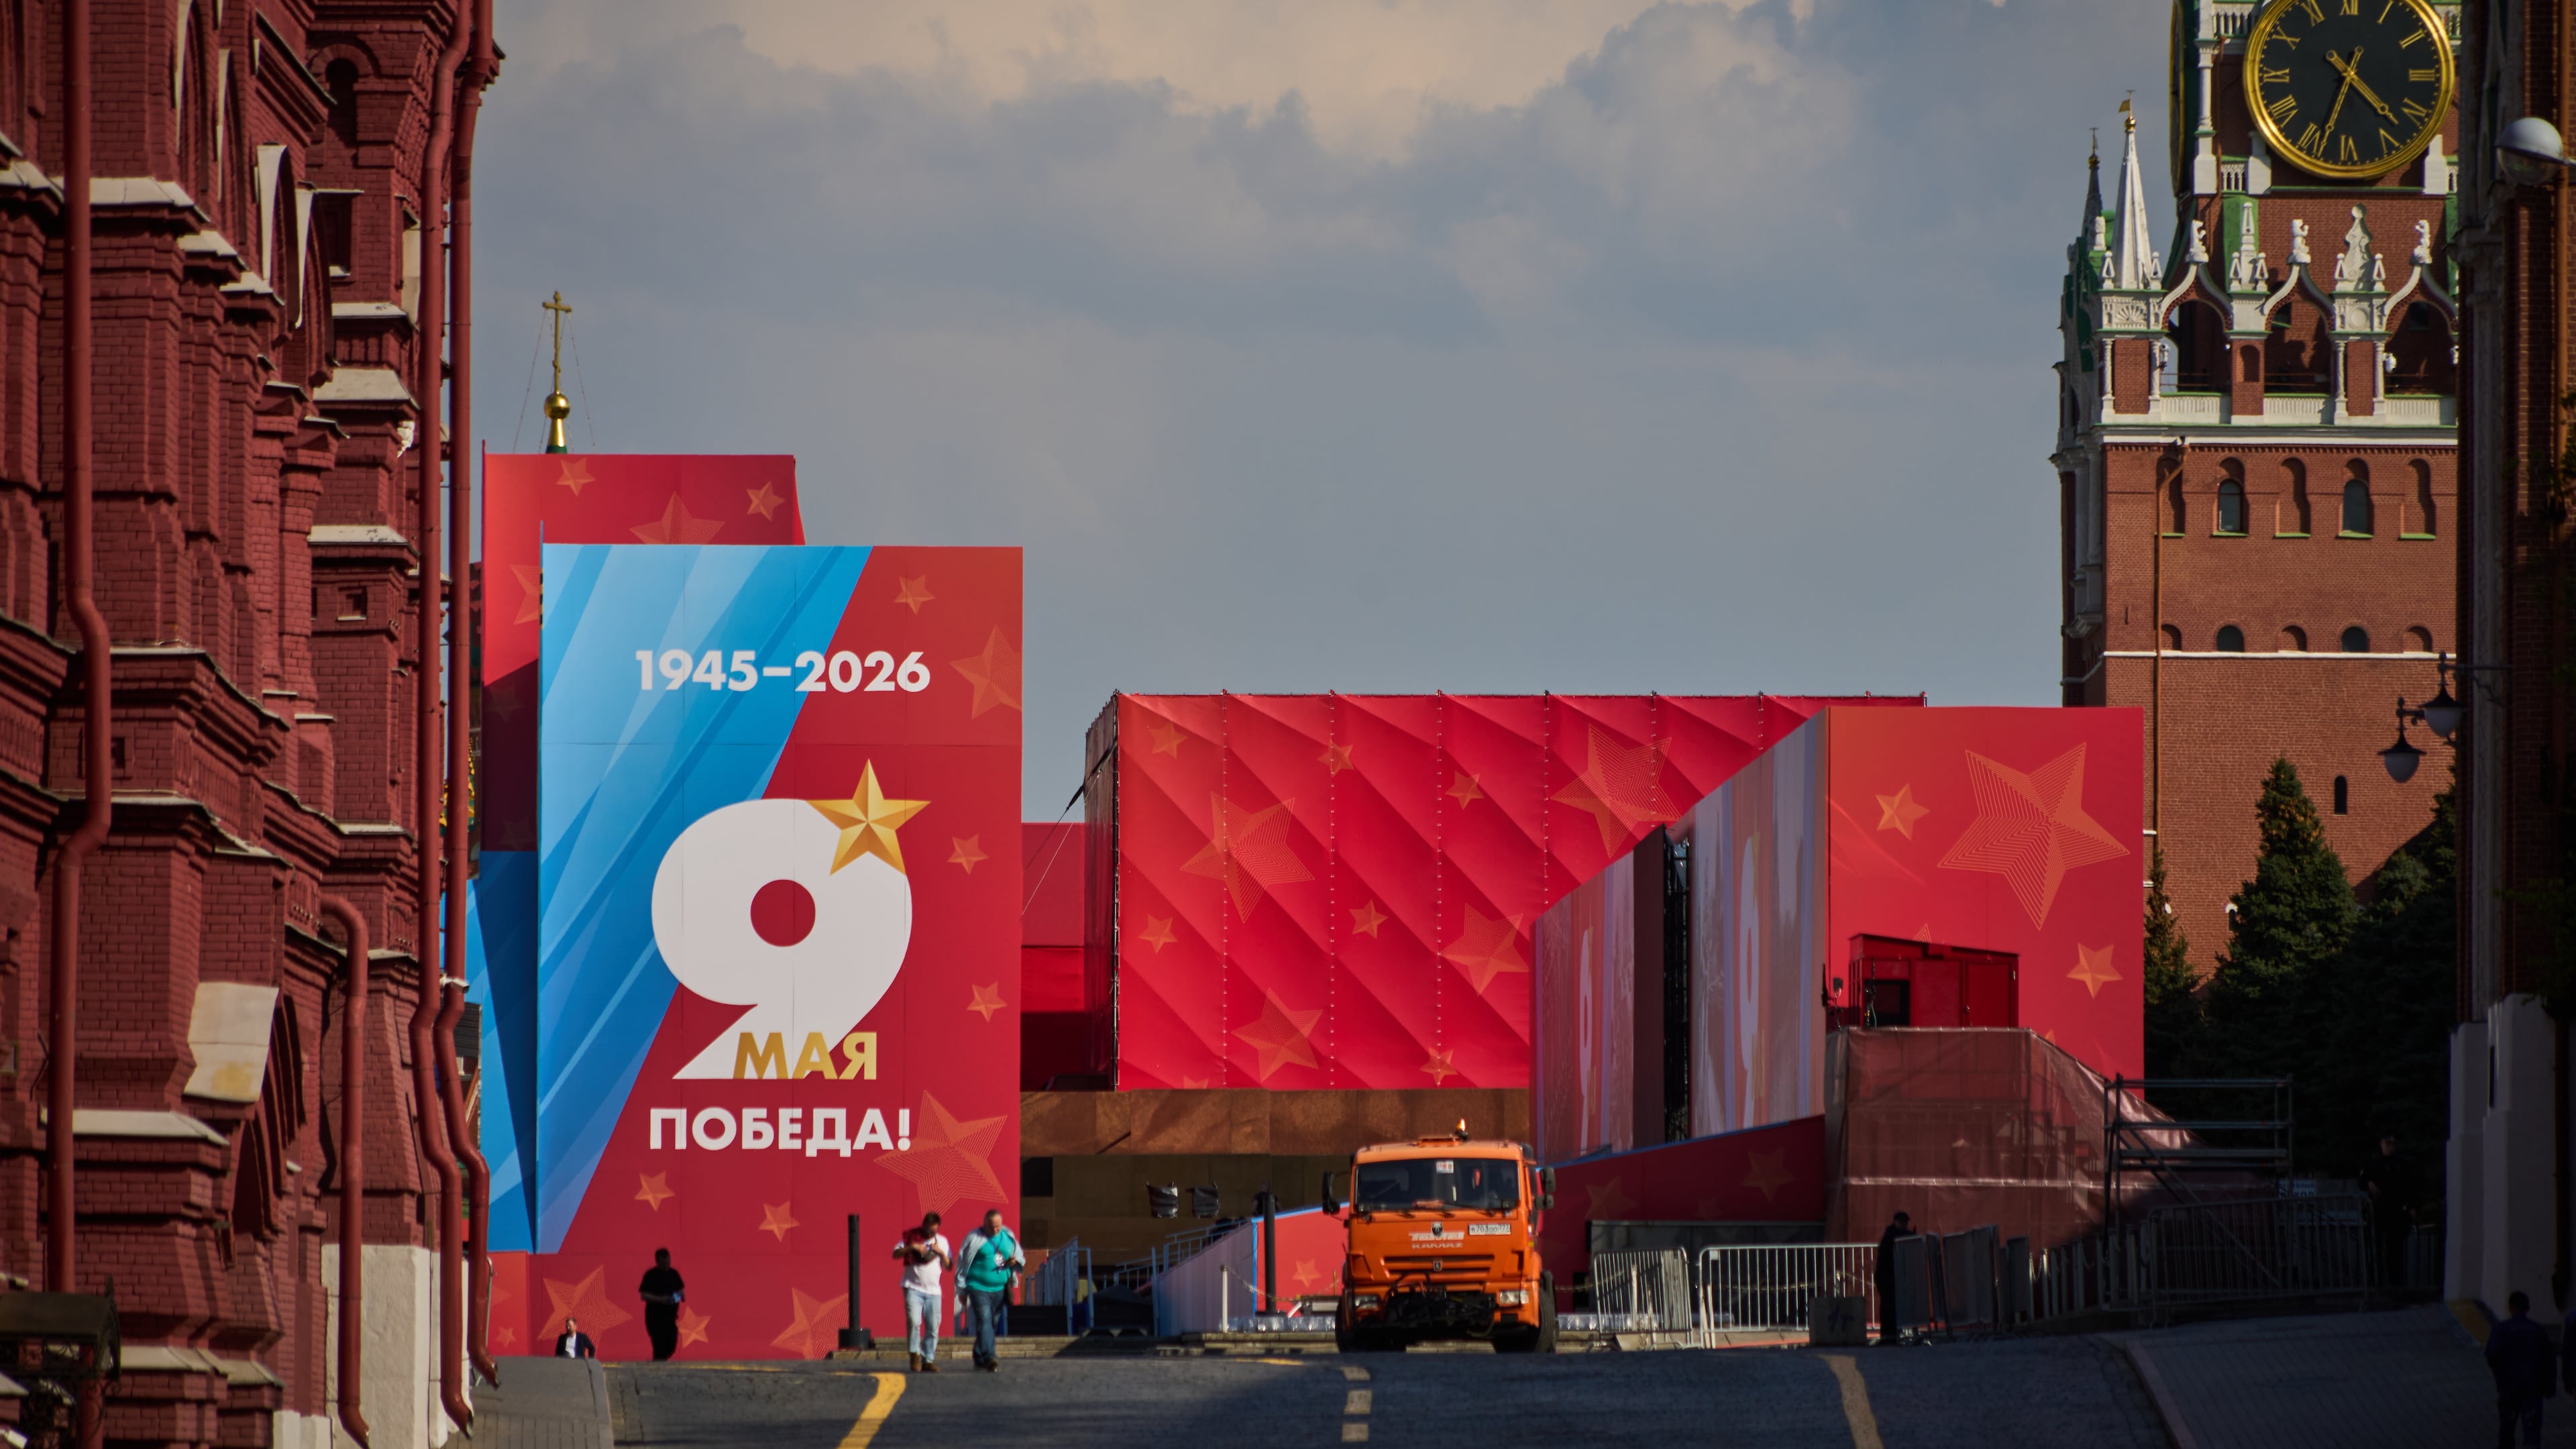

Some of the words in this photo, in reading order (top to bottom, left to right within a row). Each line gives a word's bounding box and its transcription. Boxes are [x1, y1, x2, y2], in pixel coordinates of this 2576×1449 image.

[2271, 27, 2301, 51] X
[2263, 66, 2290, 83] IX
[2408, 68, 2436, 82] III
[2378, 127, 2401, 158] V
[651, 798, 912, 1080] 9
[733, 1032, 877, 1081] МАЯ
[649, 1108, 911, 1158] ПОБЕДА!
